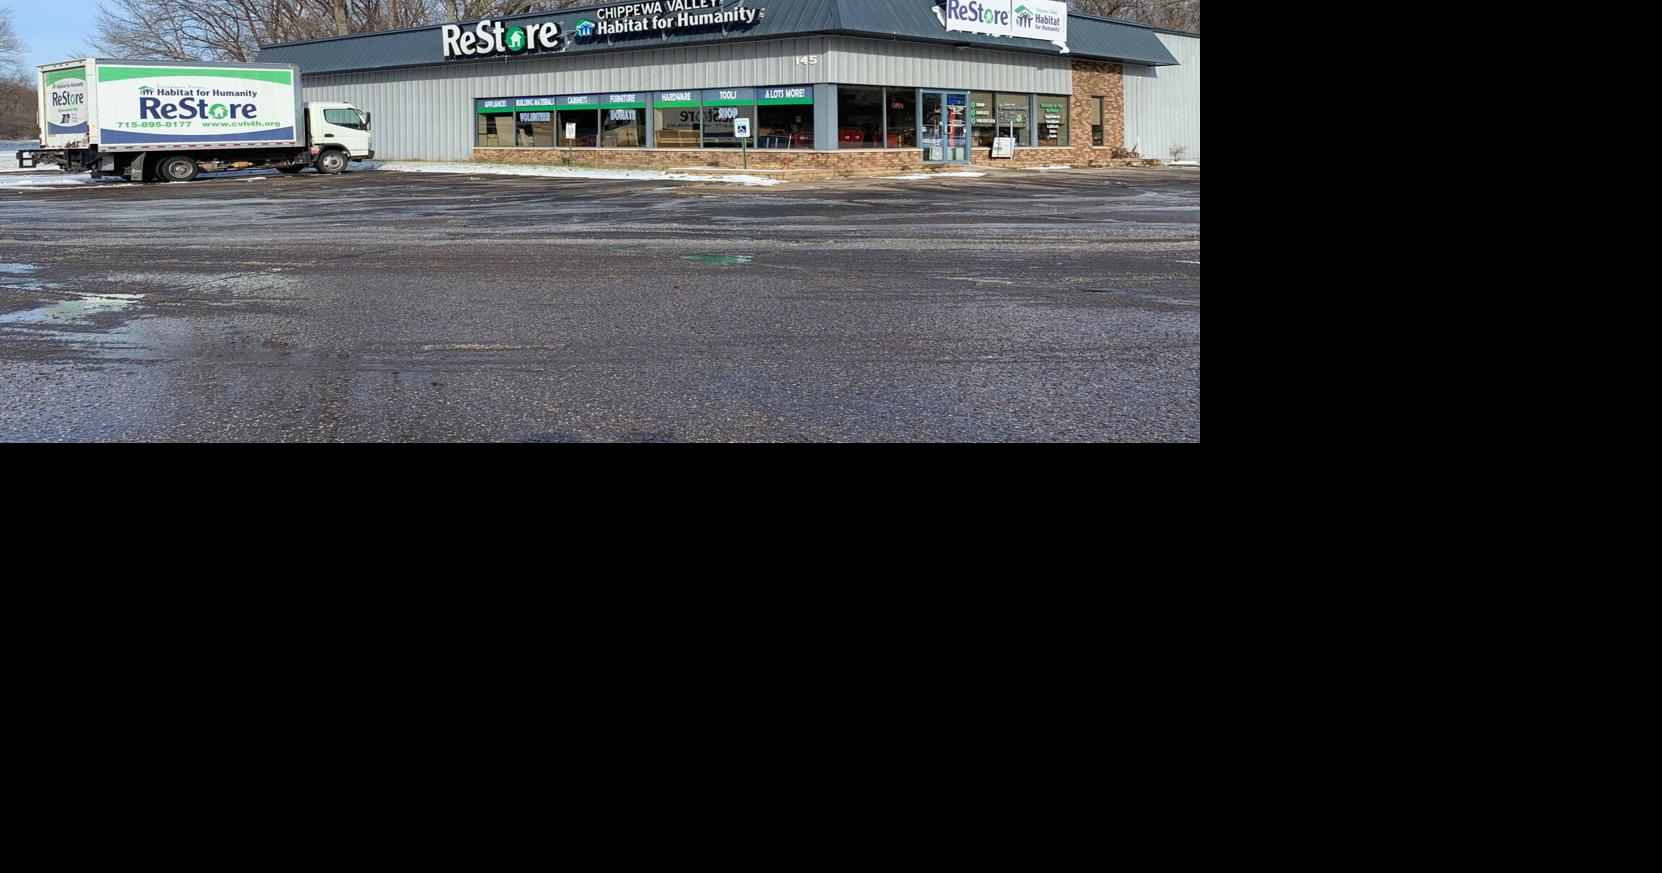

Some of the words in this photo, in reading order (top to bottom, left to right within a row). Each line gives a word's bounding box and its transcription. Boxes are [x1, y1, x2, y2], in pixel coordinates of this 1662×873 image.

[596, 2, 662, 20] CHIPPEWA
[666, 0, 719, 13] VALLEY
[948, 0, 1008, 26] ReStore
[597, 19, 649, 35] Habitat
[652, 16, 674, 30] for
[677, 7, 756, 28] Humanity
[1035, 13, 1060, 26] Habitat
[441, 20, 559, 57] ReStore
[795, 55, 818, 65] 145
[52, 90, 84, 106] ReStore
[157, 88, 194, 97] Habitat
[196, 88, 209, 97] for
[212, 89, 258, 98] Humanity
[610, 94, 636, 103] FURNITURE
[661, 92, 691, 102] HARDWARE
[719, 90, 737, 100] TOOLS
[770, 90, 784, 98] LOTS
[785, 88, 805, 98] MORE!
[139, 97, 257, 120] ReStore
[891, 102, 904, 110] OPEN
[718, 107, 739, 119] SHOP
[202, 120, 281, 128] www.cvh4h.org
